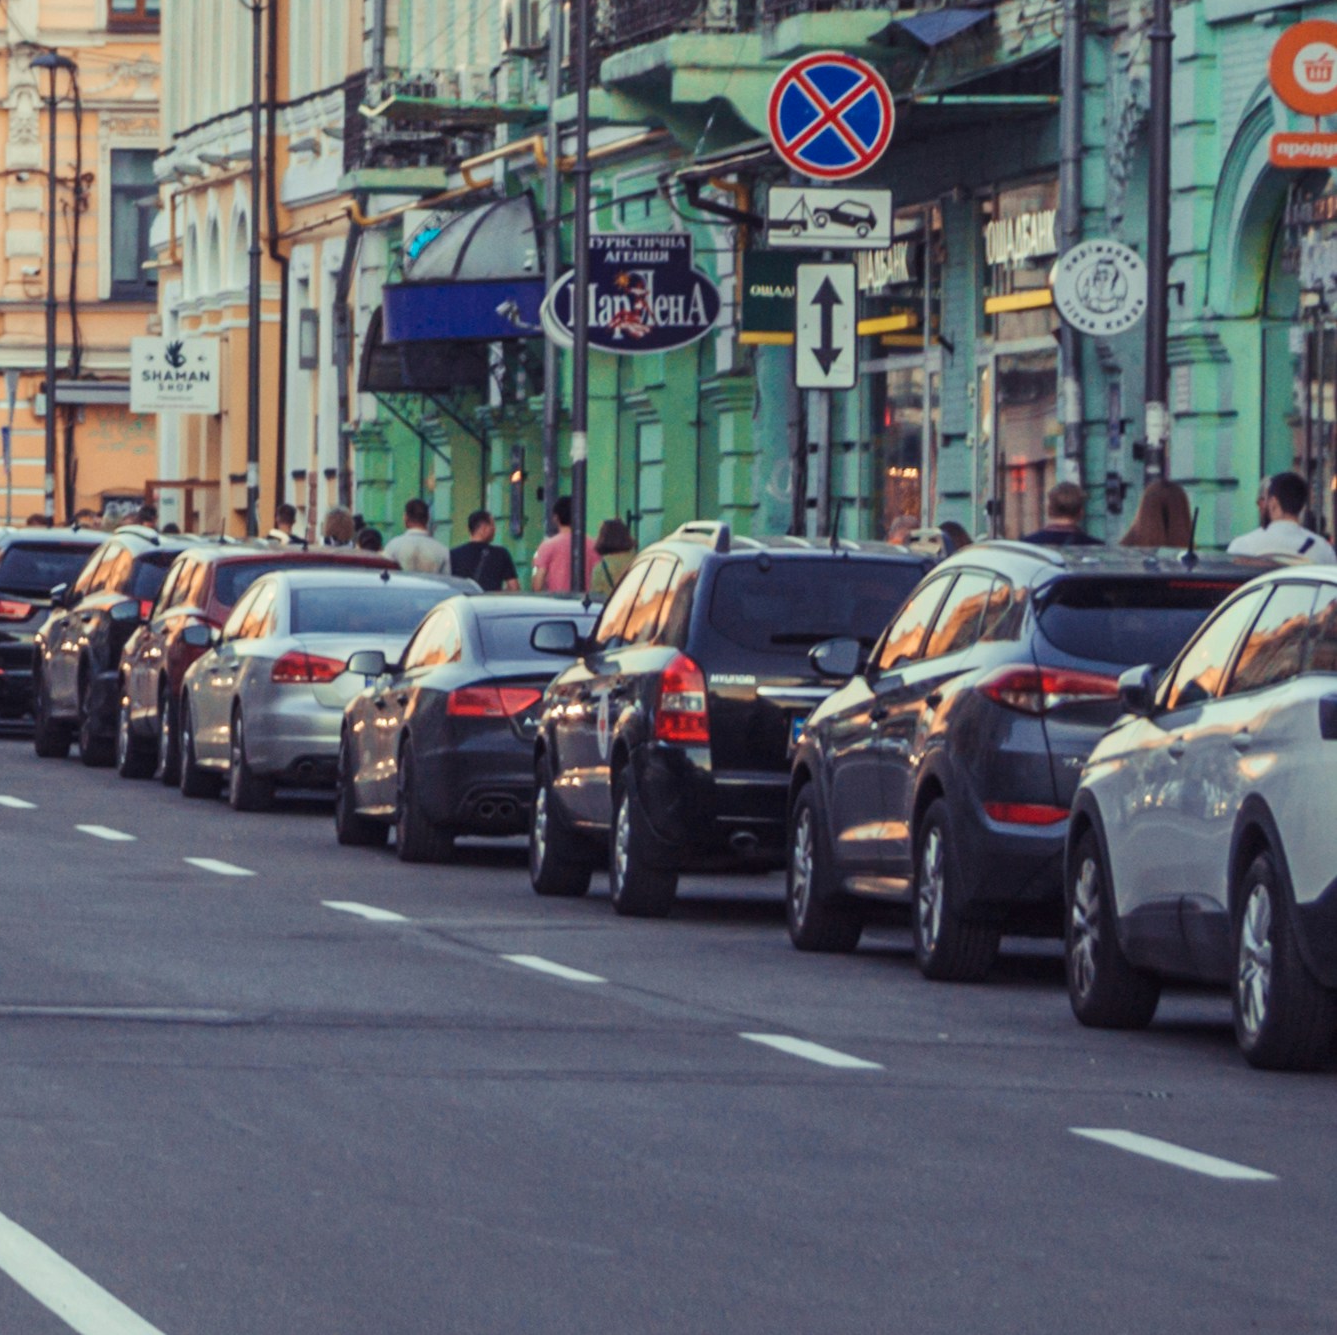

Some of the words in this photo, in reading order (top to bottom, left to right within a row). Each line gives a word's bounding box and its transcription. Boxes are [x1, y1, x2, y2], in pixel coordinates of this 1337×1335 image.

[749, 284, 795, 298] ОЩАД
[141, 370, 210, 382] SHAMAN
[158, 383, 194, 392] SHOP
